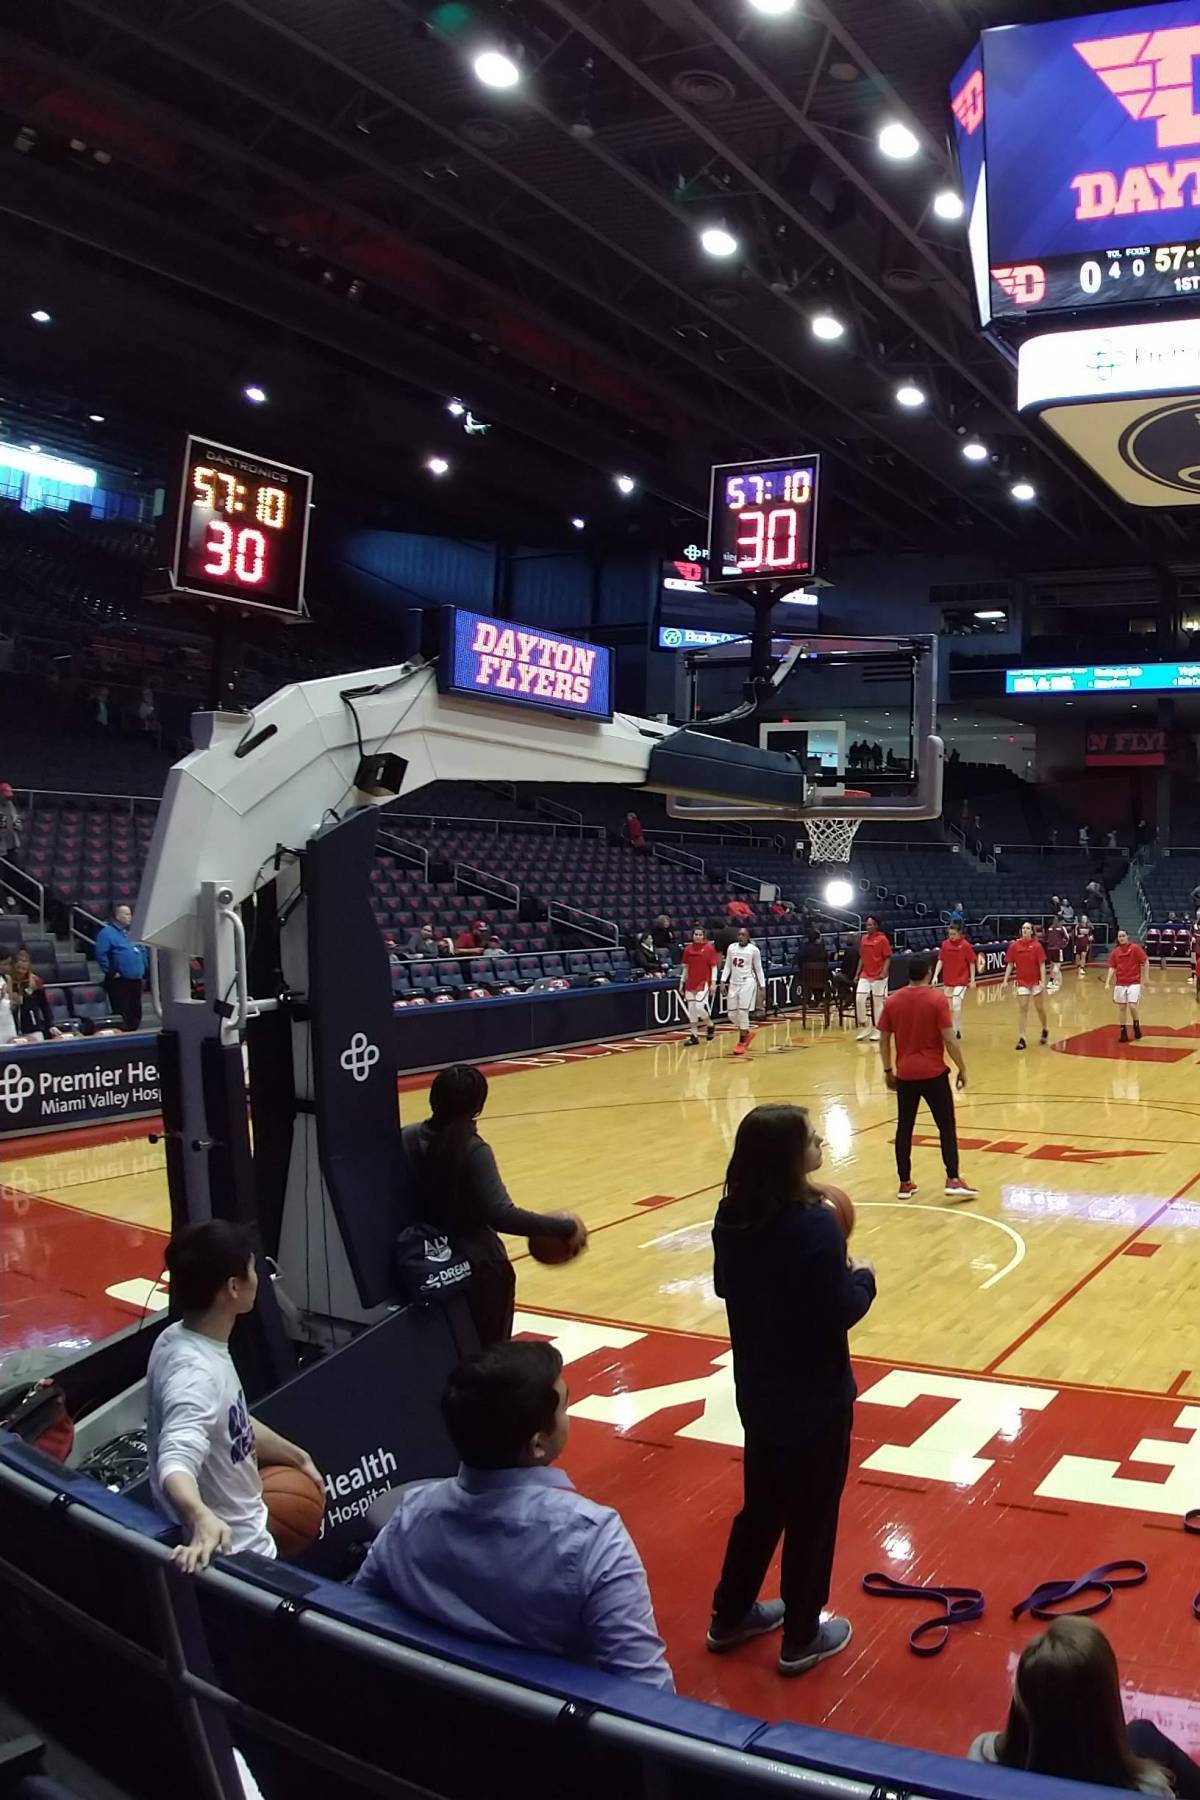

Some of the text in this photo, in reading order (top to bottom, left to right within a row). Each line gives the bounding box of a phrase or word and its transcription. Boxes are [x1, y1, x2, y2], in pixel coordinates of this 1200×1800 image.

[1079, 258, 1146, 294] 0 4 0
[1173, 276, 1200, 292] 1ST
[206, 451, 288, 483] DAKTRONICS
[193, 466, 286, 528] 57:10
[727, 470, 811, 509] 57:10
[204, 520, 266, 583] 30
[737, 508, 797, 569] 30
[472, 622, 597, 676] DAYTON
[475, 654, 591, 704] FLYERS
[732, 957, 745, 968] 42
[986, 951, 1006, 970] PNC
[39, 1064, 123, 1095] Premier
[41, 1095, 87, 1115] Miami
[88, 1089, 129, 1109] Valley
